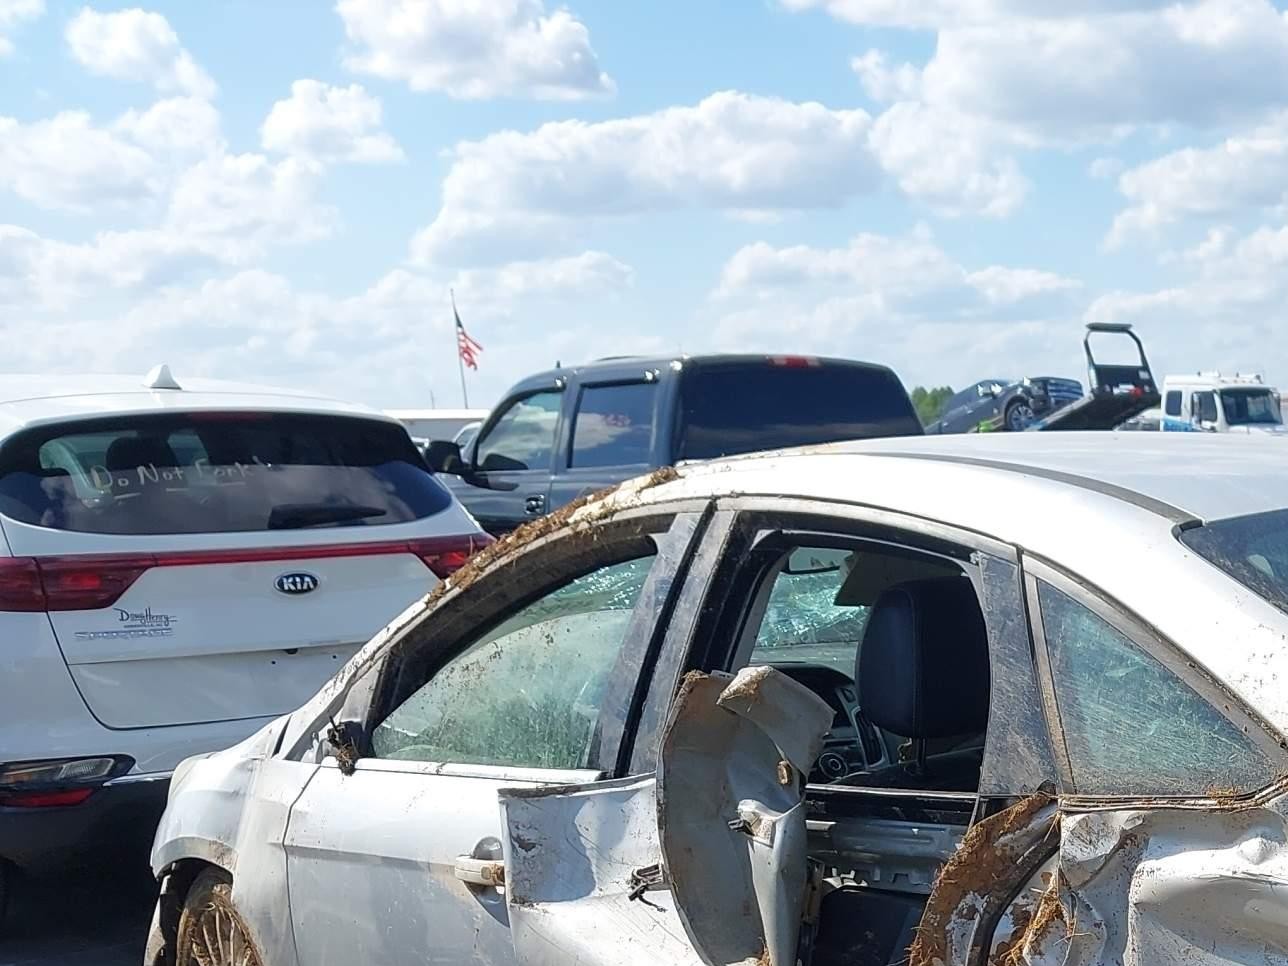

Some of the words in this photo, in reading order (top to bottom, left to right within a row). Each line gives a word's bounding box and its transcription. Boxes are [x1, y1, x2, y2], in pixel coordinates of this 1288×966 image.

[90, 465, 129, 488] Do
[137, 463, 184, 485] Not
[282, 576, 314, 590] KIA
